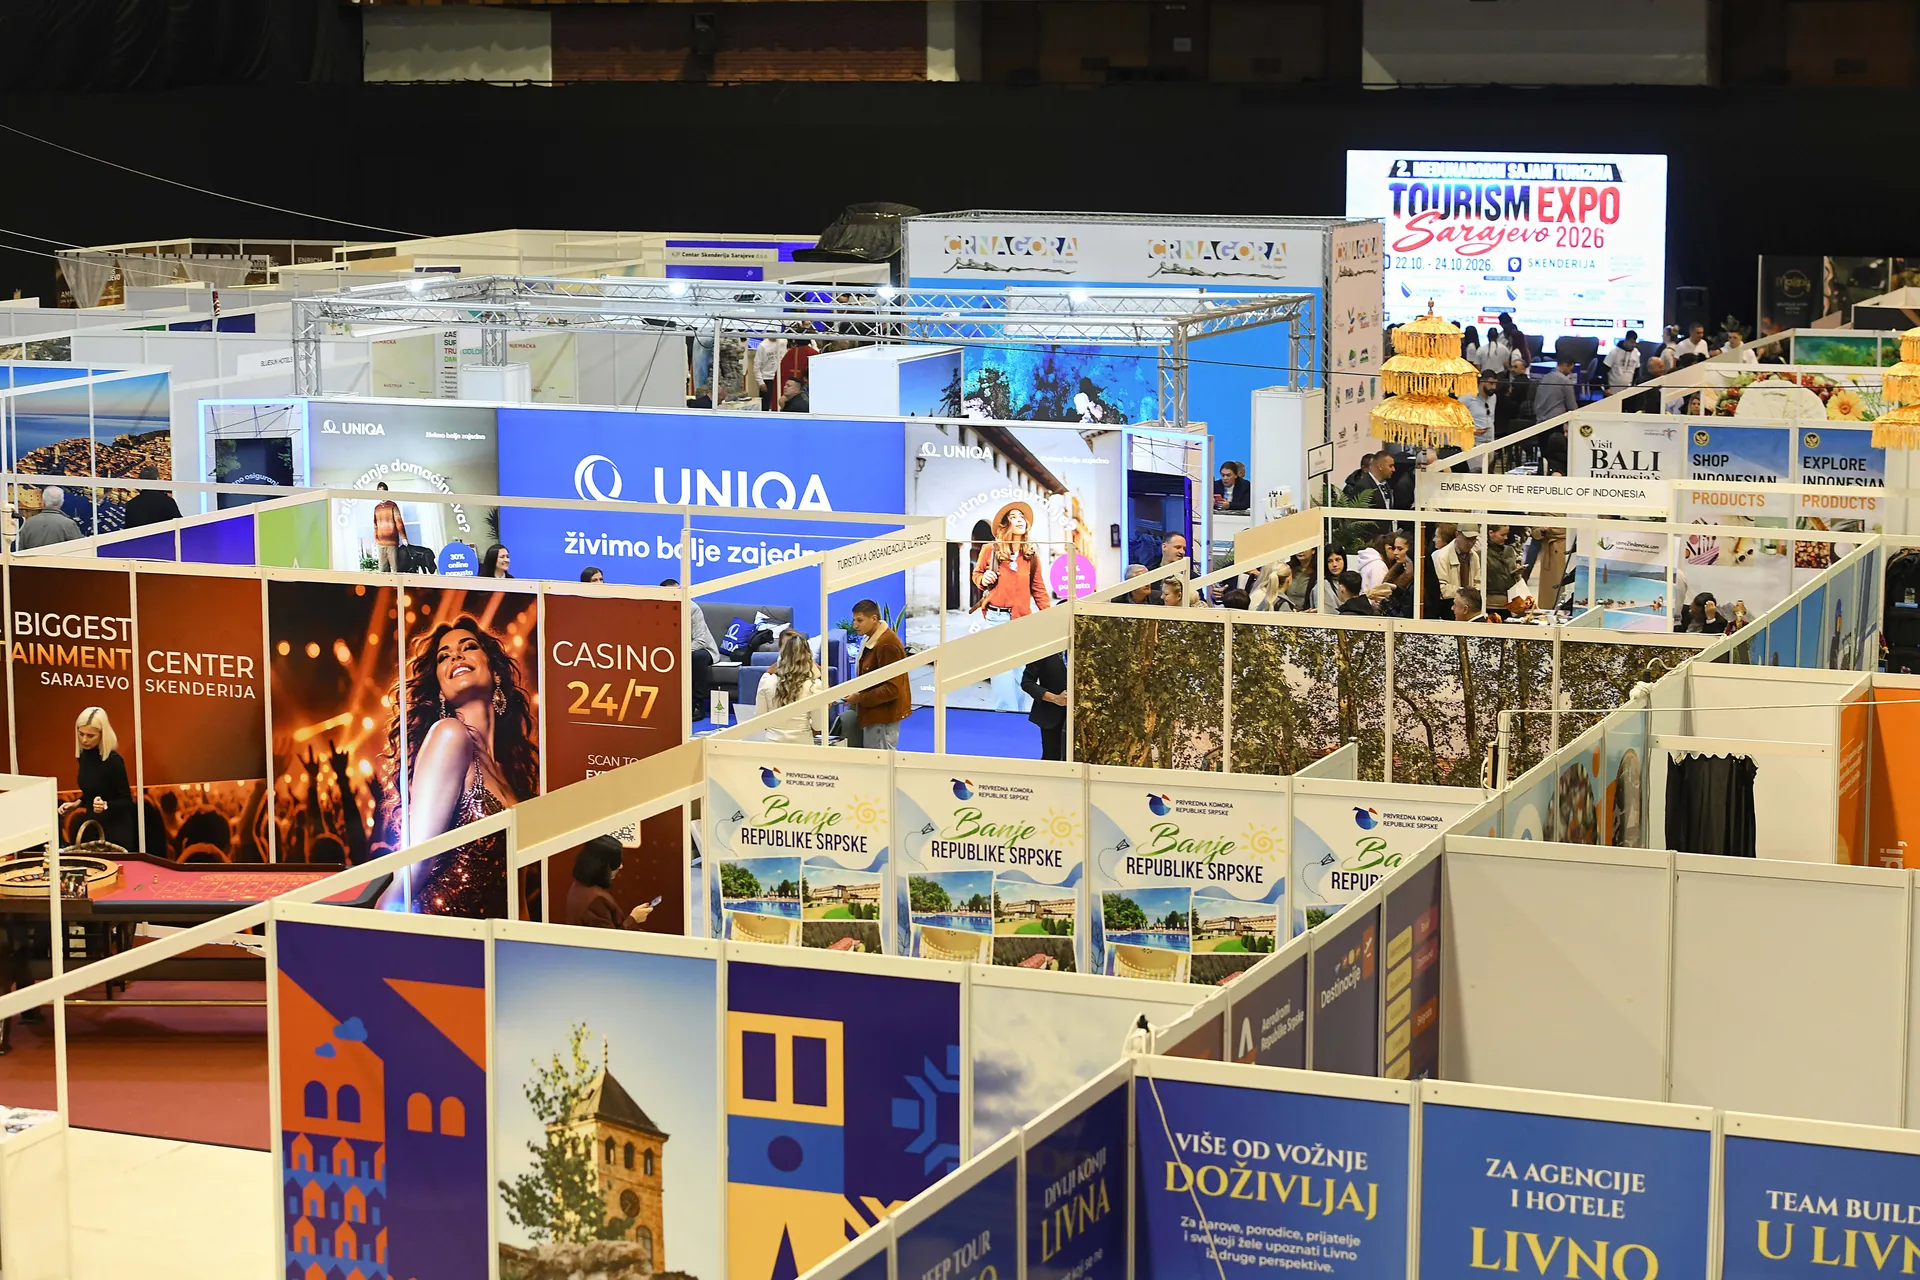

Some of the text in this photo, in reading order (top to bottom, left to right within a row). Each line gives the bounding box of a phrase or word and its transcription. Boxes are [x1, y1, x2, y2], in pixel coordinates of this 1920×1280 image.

[1388, 182, 1621, 225] TOURISM EXPO
[1392, 211, 1605, 256] Sarajevo 2026
[1528, 258, 1596, 269] SKENDERIJA
[342, 422, 386, 436] UNIQA
[943, 444, 994, 460] UNIQA
[1590, 439, 1613, 449] Visit
[1590, 449, 1661, 472] BALI
[1692, 453, 1730, 469] SHOP
[1802, 456, 1867, 473] EXPLORE
[654, 466, 833, 512] UNIQA
[1440, 482, 1647, 499] EMBASSY OF THE REPUBLIC OF INDONESIA
[1692, 491, 1766, 508] PRODUCTS
[1801, 494, 1877, 511] PRODUCTS
[946, 491, 989, 528] Putno
[563, 530, 651, 559] živimo
[14, 611, 132, 642] BIGGEST
[146, 649, 255, 679] CENTER
[552, 640, 676, 673] CASINO
[40, 671, 256, 700] SARAJEVO SKENDERIJA
[566, 678, 660, 722] 24/7
[587, 754, 620, 767] SCAN
[785, 771, 840, 782] PRIVREDNA KOMORA
[785, 779, 835, 789] REPUBLIKE SRPSKE
[978, 784, 1034, 794] PRIVREDNA KOMORA
[978, 792, 1030, 801] REPUBLIKE SRPSKE
[1175, 799, 1234, 809] PRIVREDNA KOMORA
[749, 794, 843, 835] Banje
[1175, 806, 1229, 817] REPUBLIKE SRPSKE
[1382, 812, 1443, 823] PRIVREDNA KOMORA
[1382, 820, 1438, 830] REPUBLIKE SRPSKE
[740, 827, 868, 854] REPUBLIKE SRPSKE
[940, 806, 1037, 850] Banje
[931, 840, 1063, 868] REPUBLIKE SRPSKE
[1136, 822, 1237, 865] Banje
[1126, 856, 1264, 884] REPUBLIKE SRPSKE
[1320, 964, 1361, 1009] Destinacije
[1260, 998, 1291, 1034] Aerodromi
[1175, 1131, 1369, 1173] VIŠE OD VOŽNJE
[1044, 1146, 1107, 1209] DIVLJI KONJI
[1164, 1159, 1379, 1221] DOŽIVLJAJ
[1485, 1157, 1647, 1196] ZA AGENCIJE
[1510, 1188, 1626, 1220] I HOTELE
[1765, 1189, 1839, 1217] TEAM
[1041, 1178, 1112, 1264] LIVNA
[1181, 1215, 1361, 1249] Za parove, porodice, prijatelje
[952, 1229, 992, 1275] TOUR
[1190, 1234, 1211, 1245] sve
[1213, 1232, 1236, 1249] koji
[1238, 1234, 1263, 1251] žele
[1265, 1239, 1321, 1257] upoznati
[1323, 1246, 1358, 1261] Livno
[1469, 1226, 1660, 1280] LIVNO
[1756, 1219, 1796, 1260] U
[1219, 1247, 1257, 1265] druge
[1258, 1253, 1335, 1273] perspektive.
